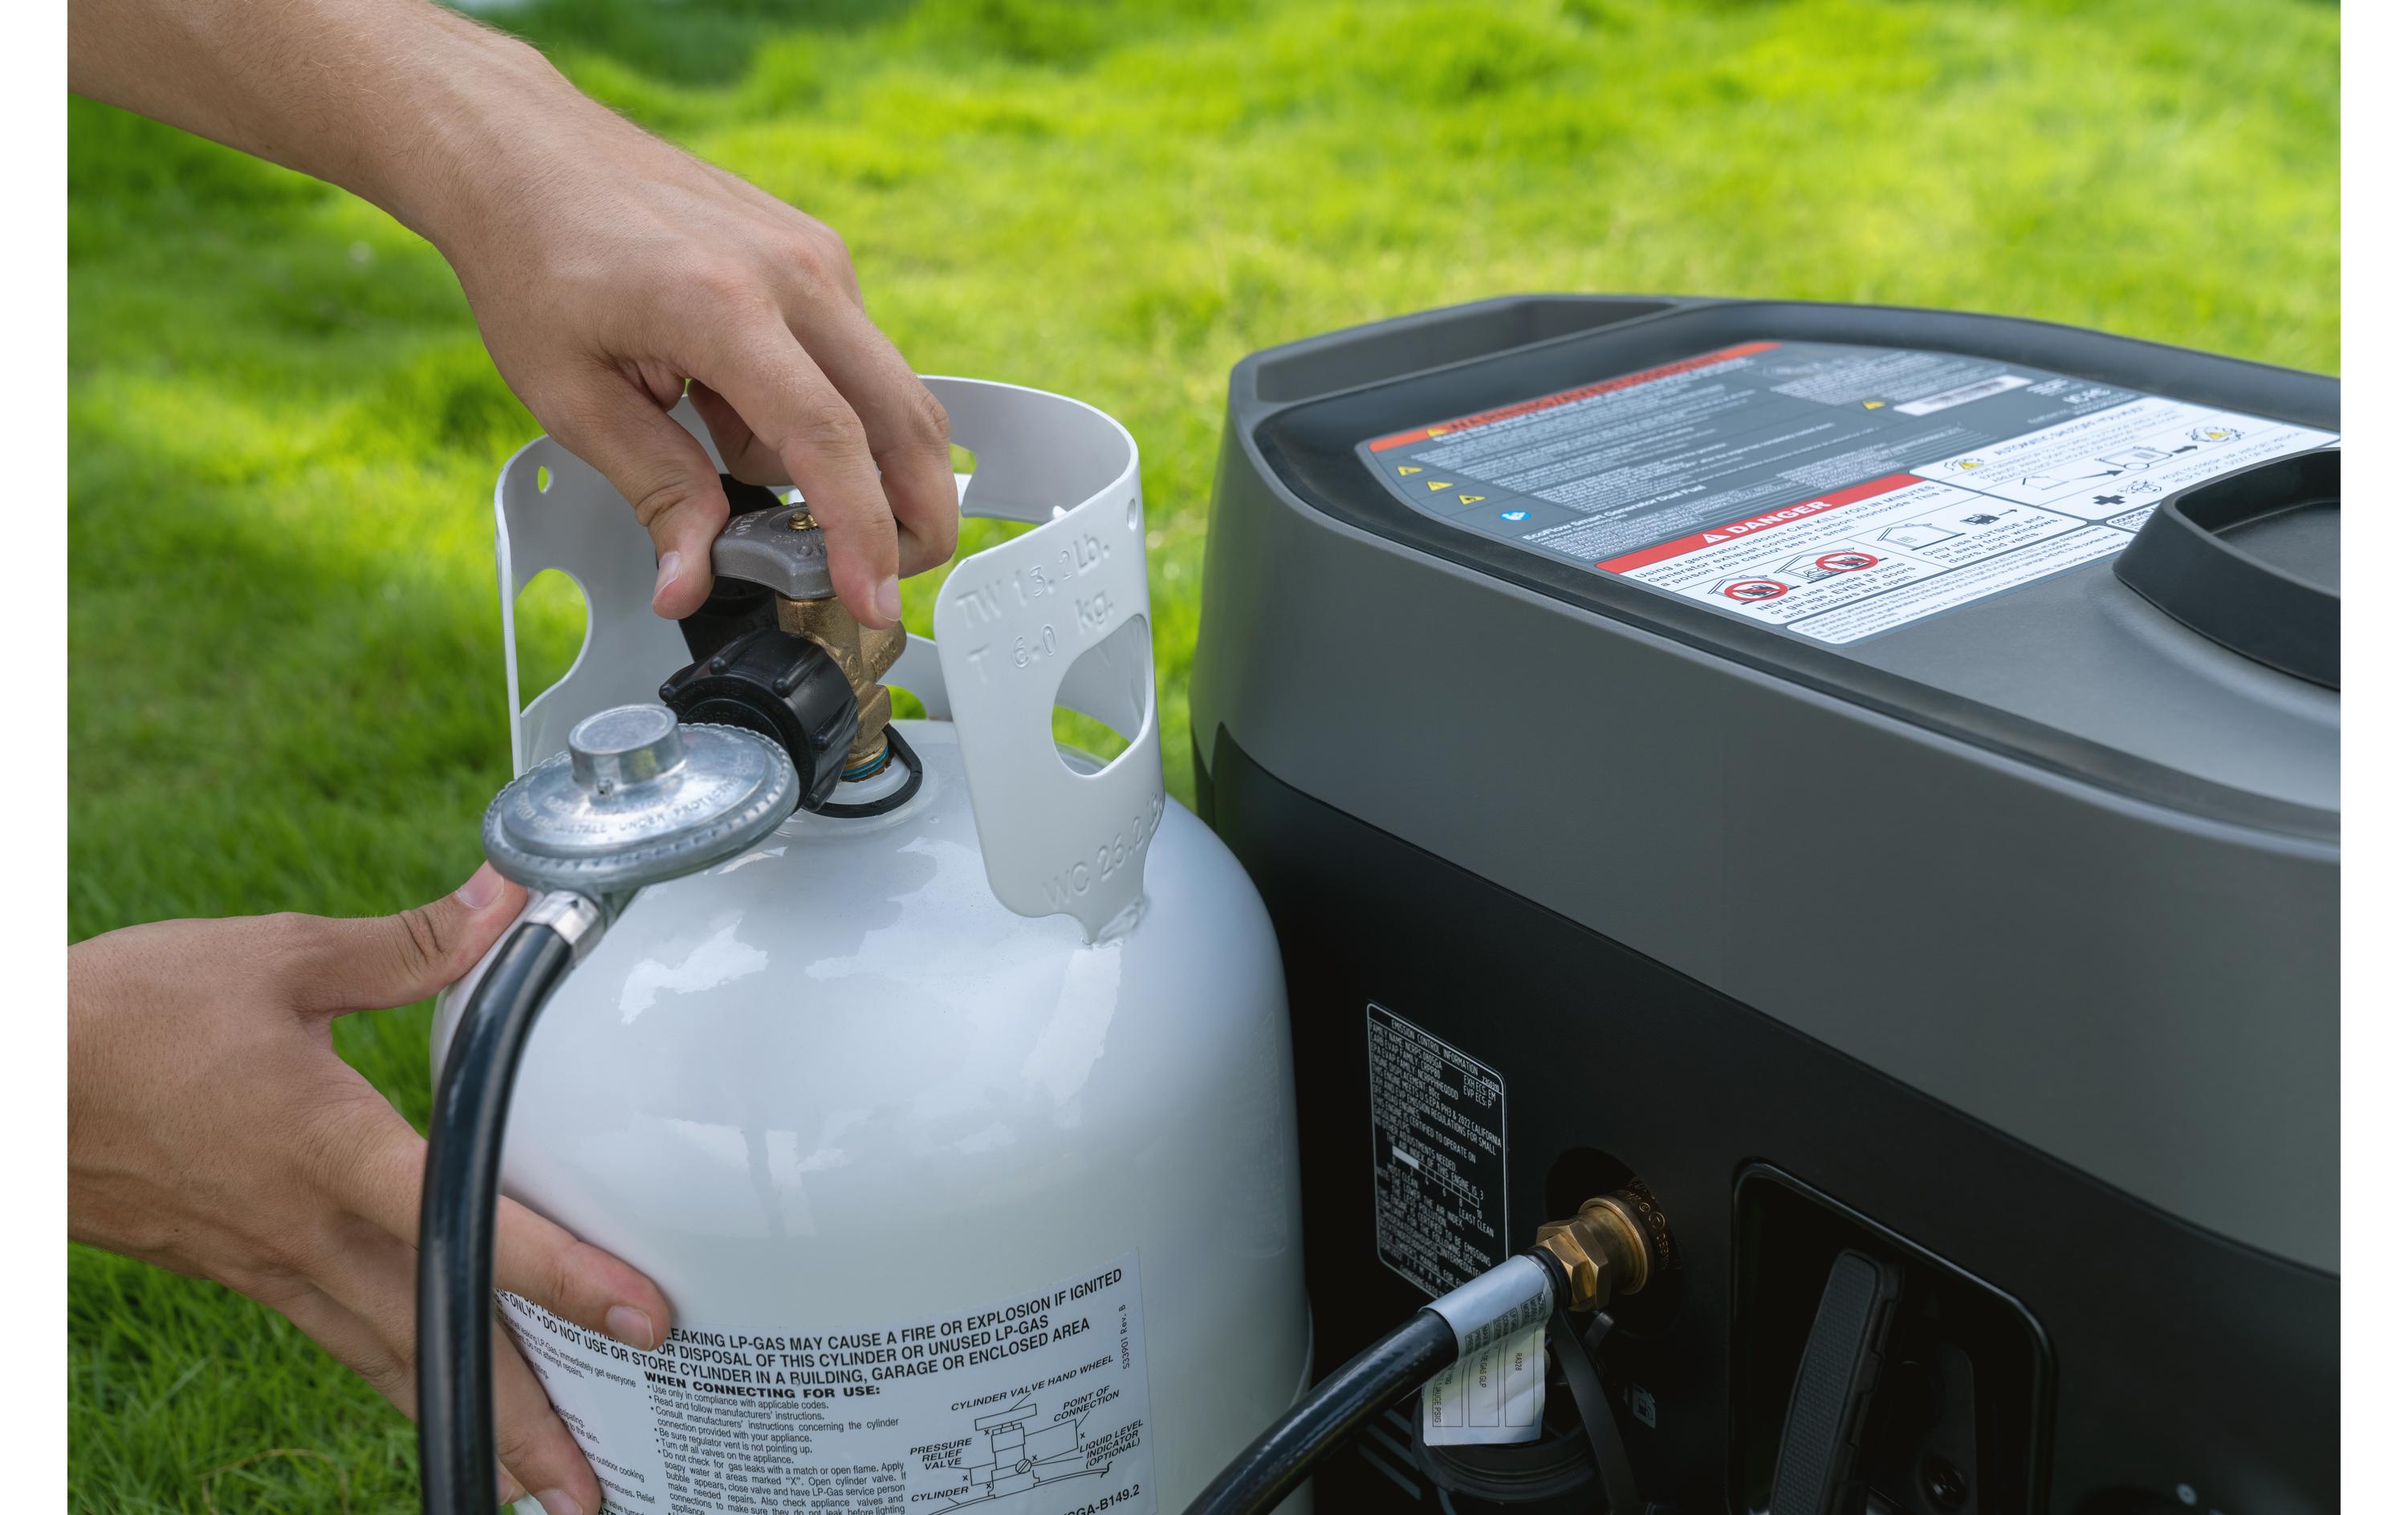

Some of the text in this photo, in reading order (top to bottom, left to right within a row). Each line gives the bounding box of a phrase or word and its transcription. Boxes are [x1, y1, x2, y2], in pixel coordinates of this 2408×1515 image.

[1725, 501, 1832, 534] DANGER
[1635, 566, 1673, 579] Using
[1684, 545, 1740, 564] generator
[1742, 530, 1786, 546] indoors
[1787, 523, 1813, 533] CAN
[1815, 515, 1841, 525] KILL
[1844, 506, 1869, 515] YOU
[1647, 562, 1710, 583] Generator
[1713, 546, 1759, 564] exhaust
[1762, 530, 1812, 549] contains
[1814, 518, 1855, 533] carbon
[1856, 500, 1914, 519] monoxide.
[1913, 492, 1939, 502] This
[1672, 569, 1714, 583] poison
[1716, 560, 1740, 571] you
[1741, 546, 1782, 562] cannot
[1784, 540, 1806, 548] see
[1823, 525, 1858, 537] smell.
[954, 579, 1003, 628] TW
[1756, 595, 1801, 611] NEVER
[1802, 588, 1824, 597] use
[1824, 575, 1862, 591] inside
[1871, 562, 1906, 575] home
[1783, 575, 1918, 619] and windows are open.
[1786, 594, 1833, 611] garage,
[1831, 583, 1866, 595] EVEN
[1881, 567, 1917, 579] doors
[968, 644, 990, 683] T
[1075, 590, 1113, 635] kg.
[1042, 862, 1090, 909] WC
[1392, 1019, 1479, 1076] EMISSION CONTROL INFORMATION
[1463, 1074, 1474, 1089] EXH
[1488, 1091, 1496, 1103] EM
[1409, 1115, 1476, 1164] CERTIFIED TO OPERATE ON
[1431, 1107, 1496, 1156] REGULATIONS FOR SMALL
[1458, 1113, 1470, 1129] 2022
[1472, 1122, 1502, 1148] CALIFORNIA
[1451, 1172, 1484, 1200] ENGINE IS 3
[1459, 1208, 1494, 1238] LEAST CLEAN
[667, 1268, 1123, 1351] EAKING LP-GAS MAY CAUSE A FIRE OR EXPLOSION IF IGNITED
[542, 1317, 557, 1334] DO
[559, 1324, 582, 1346] NOT
[584, 1337, 609, 1356] USE
[610, 1346, 628, 1363] OR
[632, 1351, 677, 1374] STORE
[680, 1362, 752, 1384] CYLINDER
[755, 1371, 771, 1385] IN
[775, 1371, 786, 1386] A
[871, 1359, 938, 1381] GARAGE
[942, 1355, 965, 1371] OR
[969, 1331, 1049, 1366] ENCLOSED
[1052, 1318, 1091, 1343] AREA
[679, 1345, 752, 1367] DISPOSAL
[755, 1354, 776, 1368] OF
[780, 1354, 816, 1368] THIS
[819, 1348, 897, 1368] CYLINDER
[901, 1345, 924, 1361] OR
[929, 1330, 992, 1356] UNUSED
[995, 1314, 1049, 1342] LP-GAS
[644, 1371, 881, 1399] WHEN CONNECTING FOR USE:
[652, 1383, 829, 1411] Use only in compliance with applicable codes.
[951, 1355, 1114, 1411] CYLINDER VALVE HAND WHEEL
[1063, 1385, 1112, 1410] POINT OF
[653, 1395, 673, 1407] Read
[674, 1400, 689, 1411] and
[690, 1401, 713, 1415] follow
[775, 1409, 825, 1420] instructions.
[1053, 1389, 1120, 1423] CONNECTION
[1434, 1406, 1442, 1423] PSIG
[909, 1437, 973, 1456] PRESSURE
[1080, 1419, 1144, 1454] LIQUID LEVEL
[1085, 1437, 1141, 1469] (OPTIONAL)
[1086, 1429, 1139, 1459] INDICATOR
[921, 1448, 963, 1462] RELIEF
[924, 1456, 962, 1471] VALVE
[911, 1486, 969, 1502] CYLINDER
